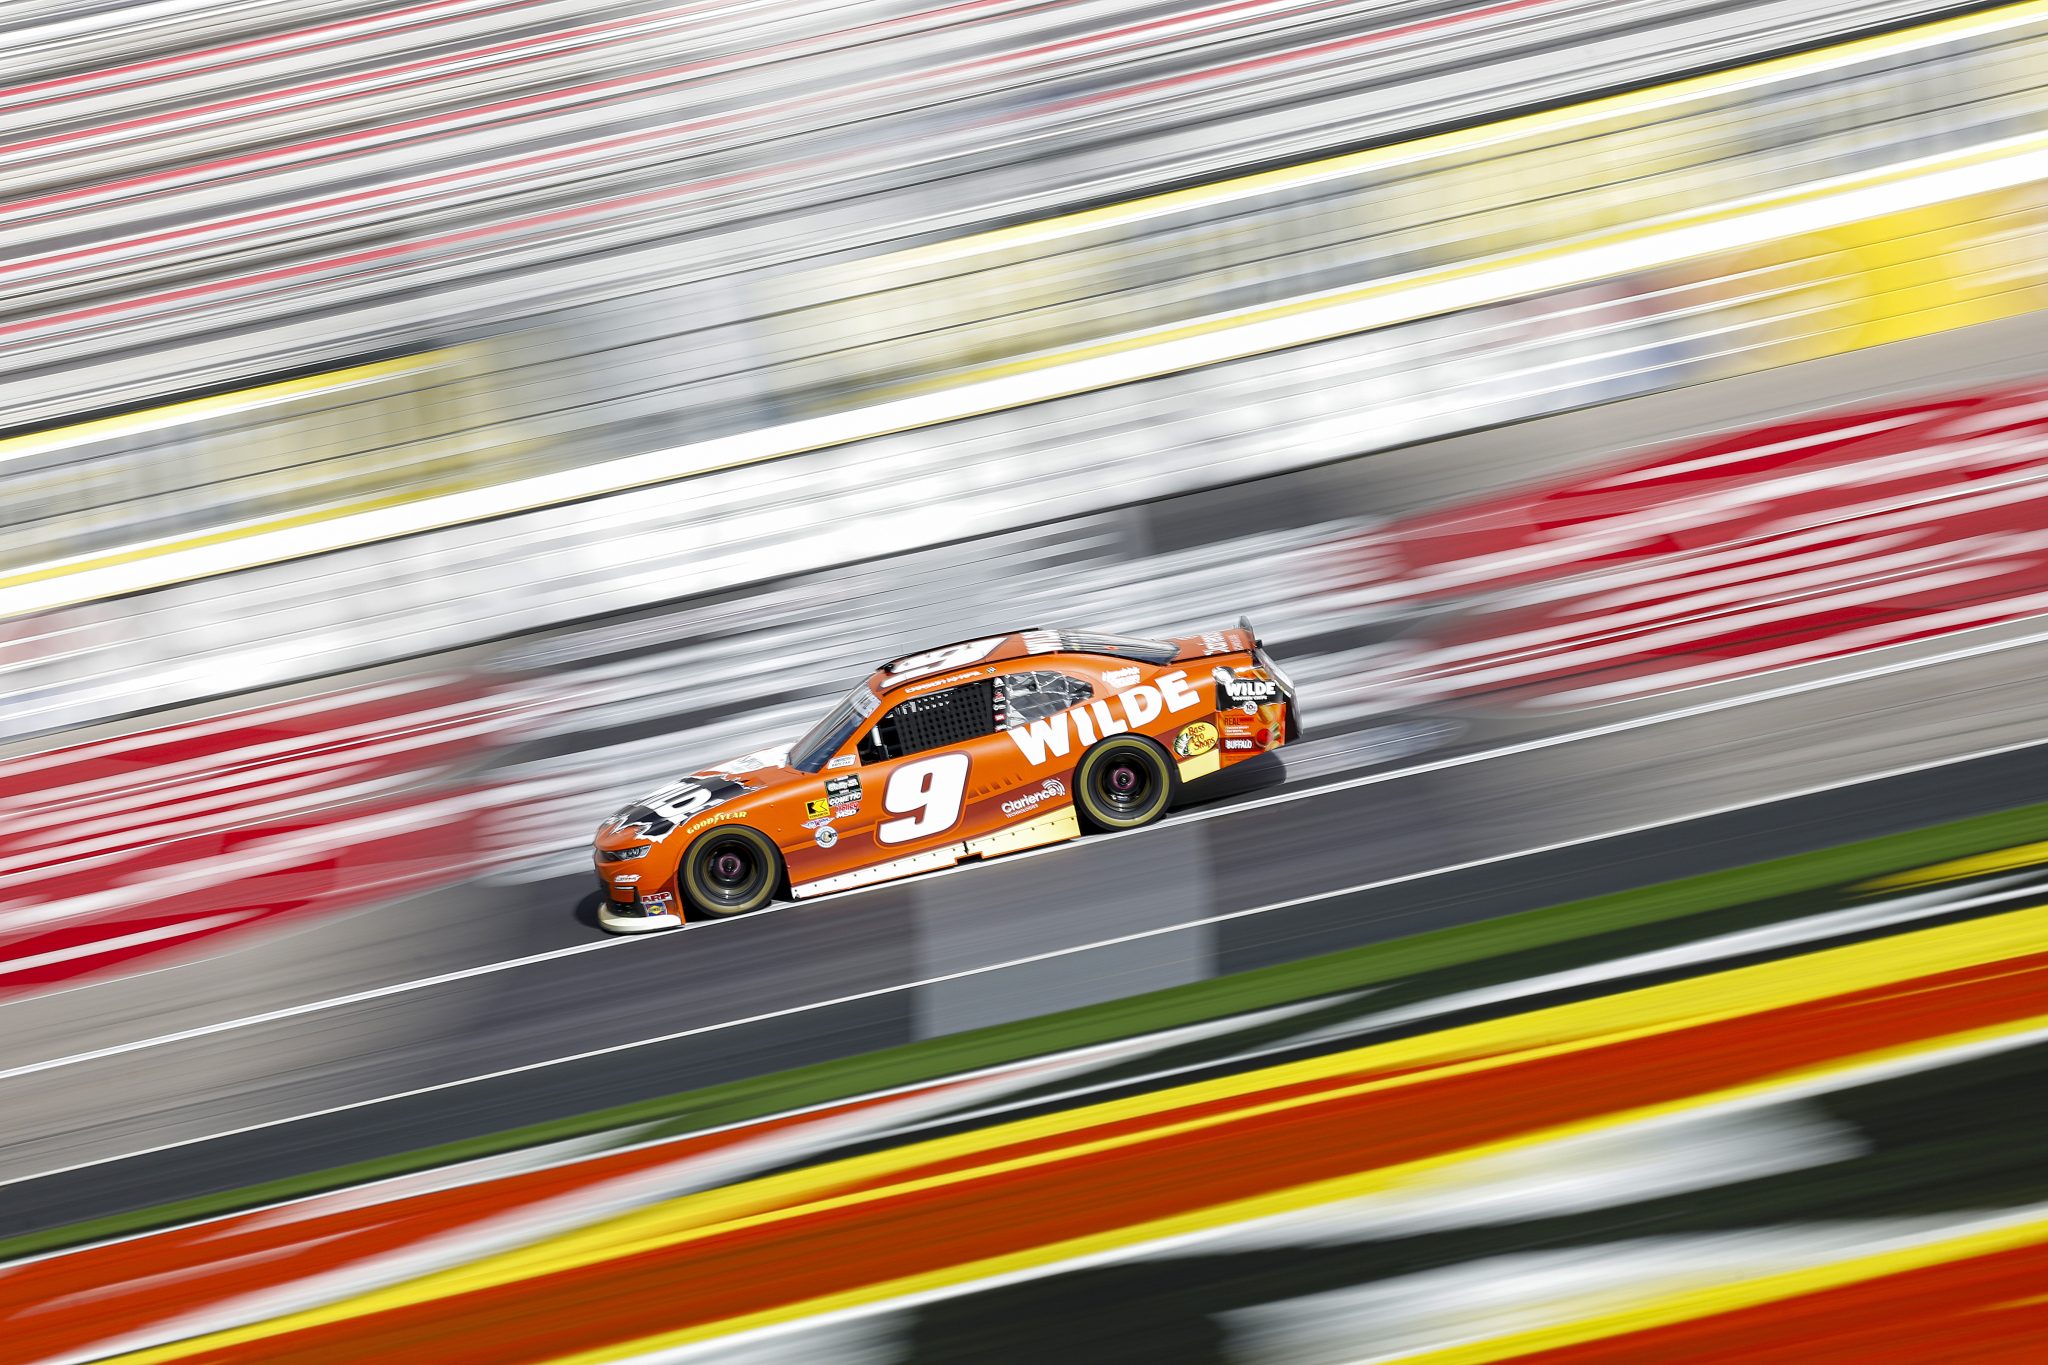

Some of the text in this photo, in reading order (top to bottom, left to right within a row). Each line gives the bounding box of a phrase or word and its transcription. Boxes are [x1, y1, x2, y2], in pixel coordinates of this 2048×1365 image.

[1224, 681, 1276, 697] WILDE
[1007, 669, 1201, 767] WILDE
[1224, 717, 1241, 726] REAL
[1188, 725, 1206, 736] Bass
[1192, 733, 1205, 744] Pro
[1194, 737, 1216, 751] Shops
[1225, 739, 1253, 749] BUFFALO
[829, 792, 861, 805] COMETIC
[878, 752, 970, 844] 9
[1001, 786, 1057, 814] Clarience
[687, 811, 748, 834] GOODYEAR
[642, 892, 671, 902] ARP
